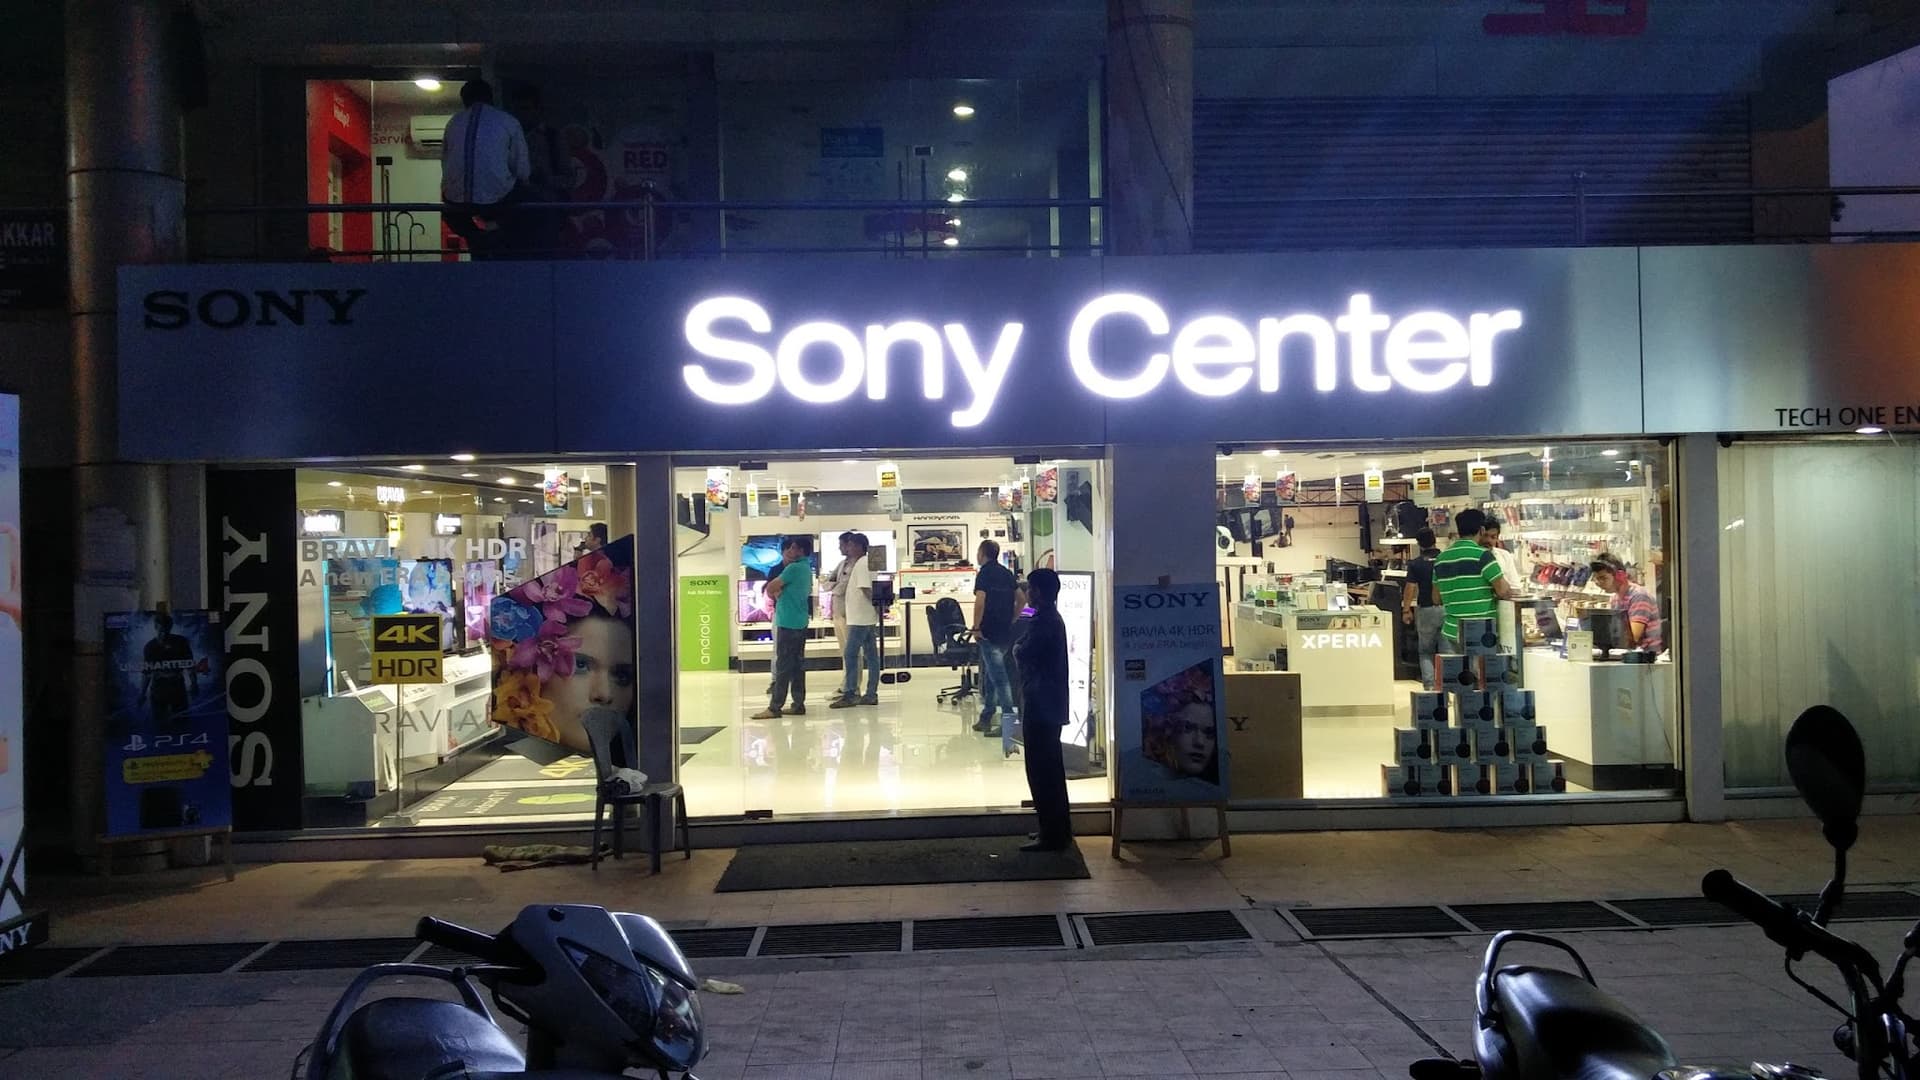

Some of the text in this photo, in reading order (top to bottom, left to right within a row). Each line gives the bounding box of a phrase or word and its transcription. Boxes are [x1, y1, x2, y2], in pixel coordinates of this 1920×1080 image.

[371, 132, 412, 145] Servic
[624, 150, 668, 168] RED
[0, 222, 56, 247] KKAR
[144, 289, 367, 329] SONY
[683, 293, 1523, 427] Sony Center
[1775, 408, 1831, 427] TECH
[1838, 407, 1886, 426] ONE
[466, 538, 527, 560] HDR
[300, 569, 316, 586] A
[1062, 580, 1088, 590] SONY
[1124, 592, 1210, 609] SONY
[377, 624, 436, 643] 4K
[699, 614, 711, 665] android
[1121, 624, 1216, 638] BRAVIA 4K HDR
[1301, 632, 1383, 649] XPERIA
[222, 515, 273, 788] SONY
[377, 658, 437, 677] HDR
[375, 709, 482, 733] RAVIA
[154, 732, 209, 748] PS4
